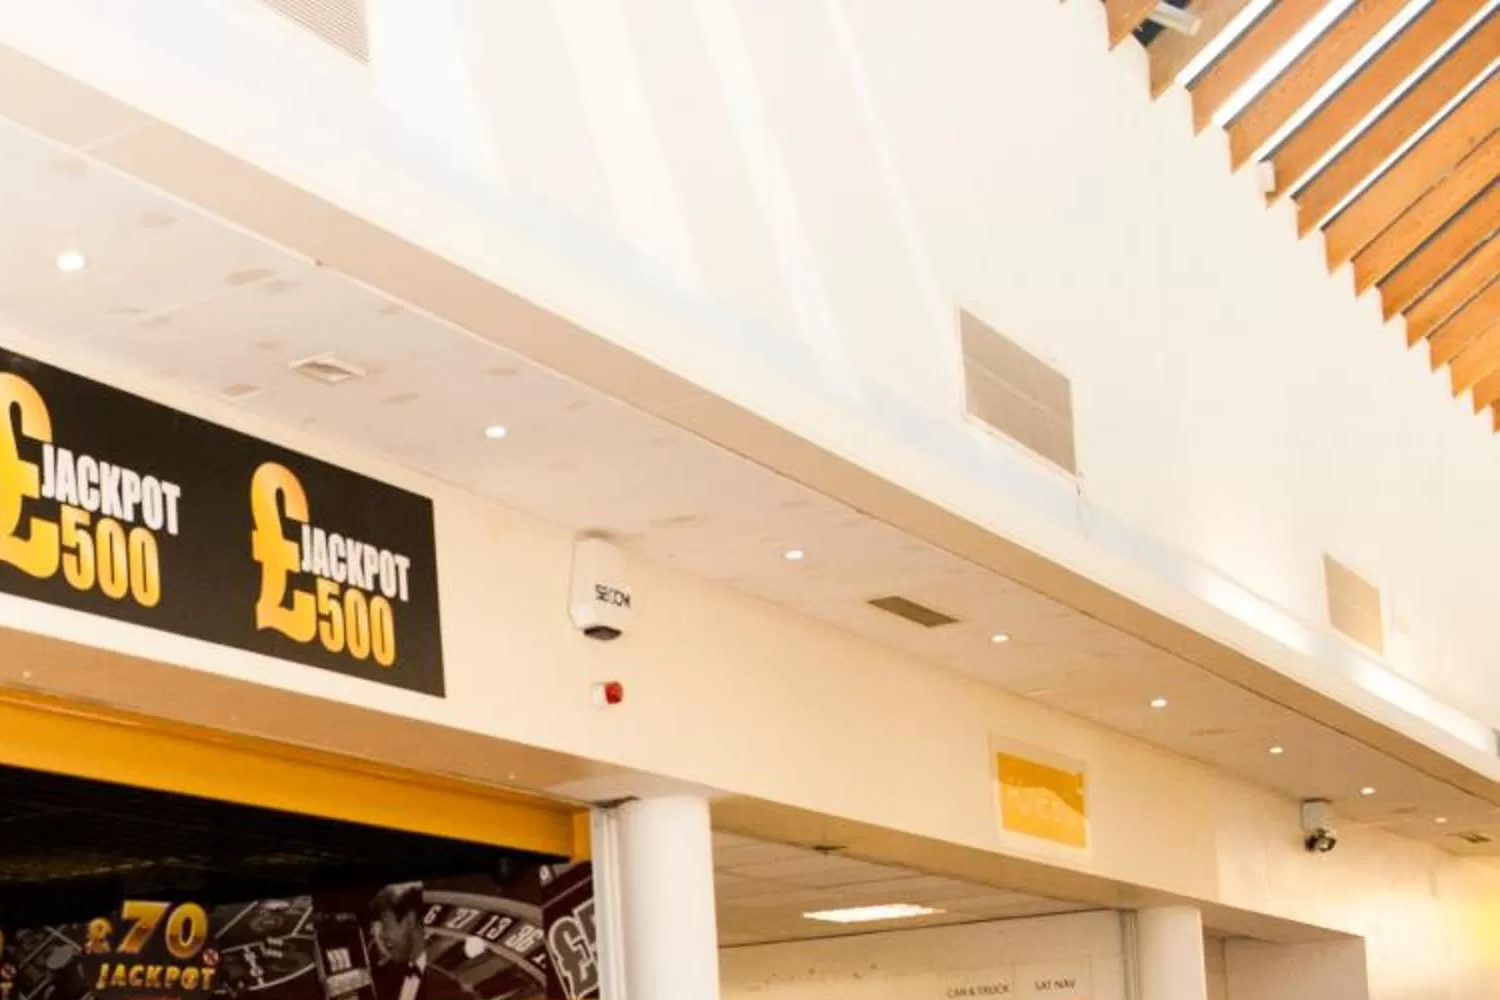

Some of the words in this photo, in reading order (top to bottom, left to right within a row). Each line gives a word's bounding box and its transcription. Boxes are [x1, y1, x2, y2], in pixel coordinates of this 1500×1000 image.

[41, 443, 181, 536] JACKPOT
[301, 523, 410, 601] JACKPOT
[476, 915, 513, 940] 13
[96, 963, 215, 991] JACKPOT
[978, 983, 1009, 995] TRUCK
[1034, 979, 1052, 992] SAT
[1055, 977, 1077, 990] NAV
